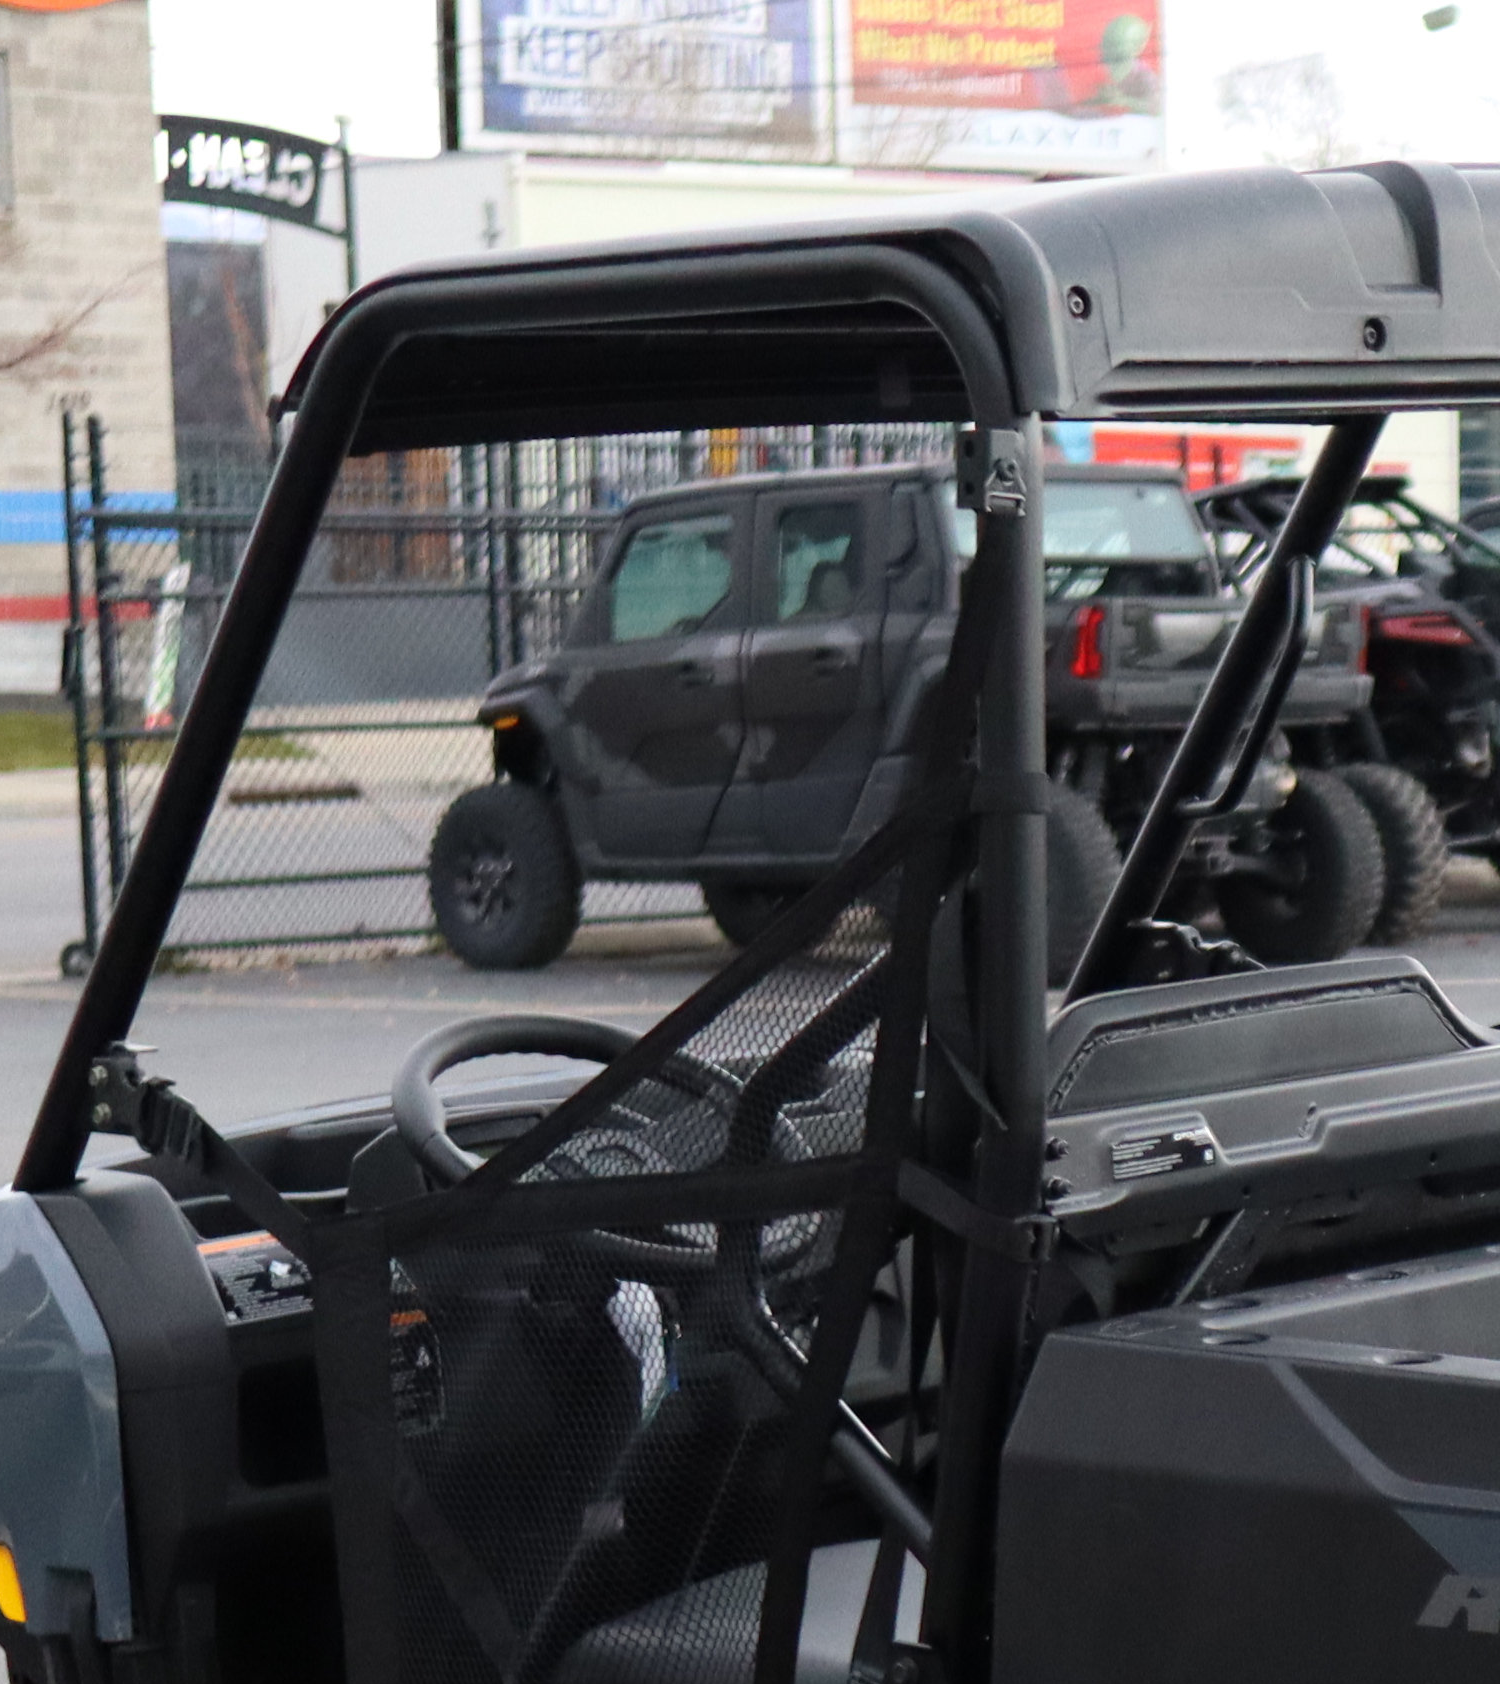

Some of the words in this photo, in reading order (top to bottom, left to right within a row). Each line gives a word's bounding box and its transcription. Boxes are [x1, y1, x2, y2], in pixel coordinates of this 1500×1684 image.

[515, 25, 605, 77] KEEP
[856, 28, 922, 62] What
[926, 30, 962, 65] We
[967, 32, 1057, 68] Protect
